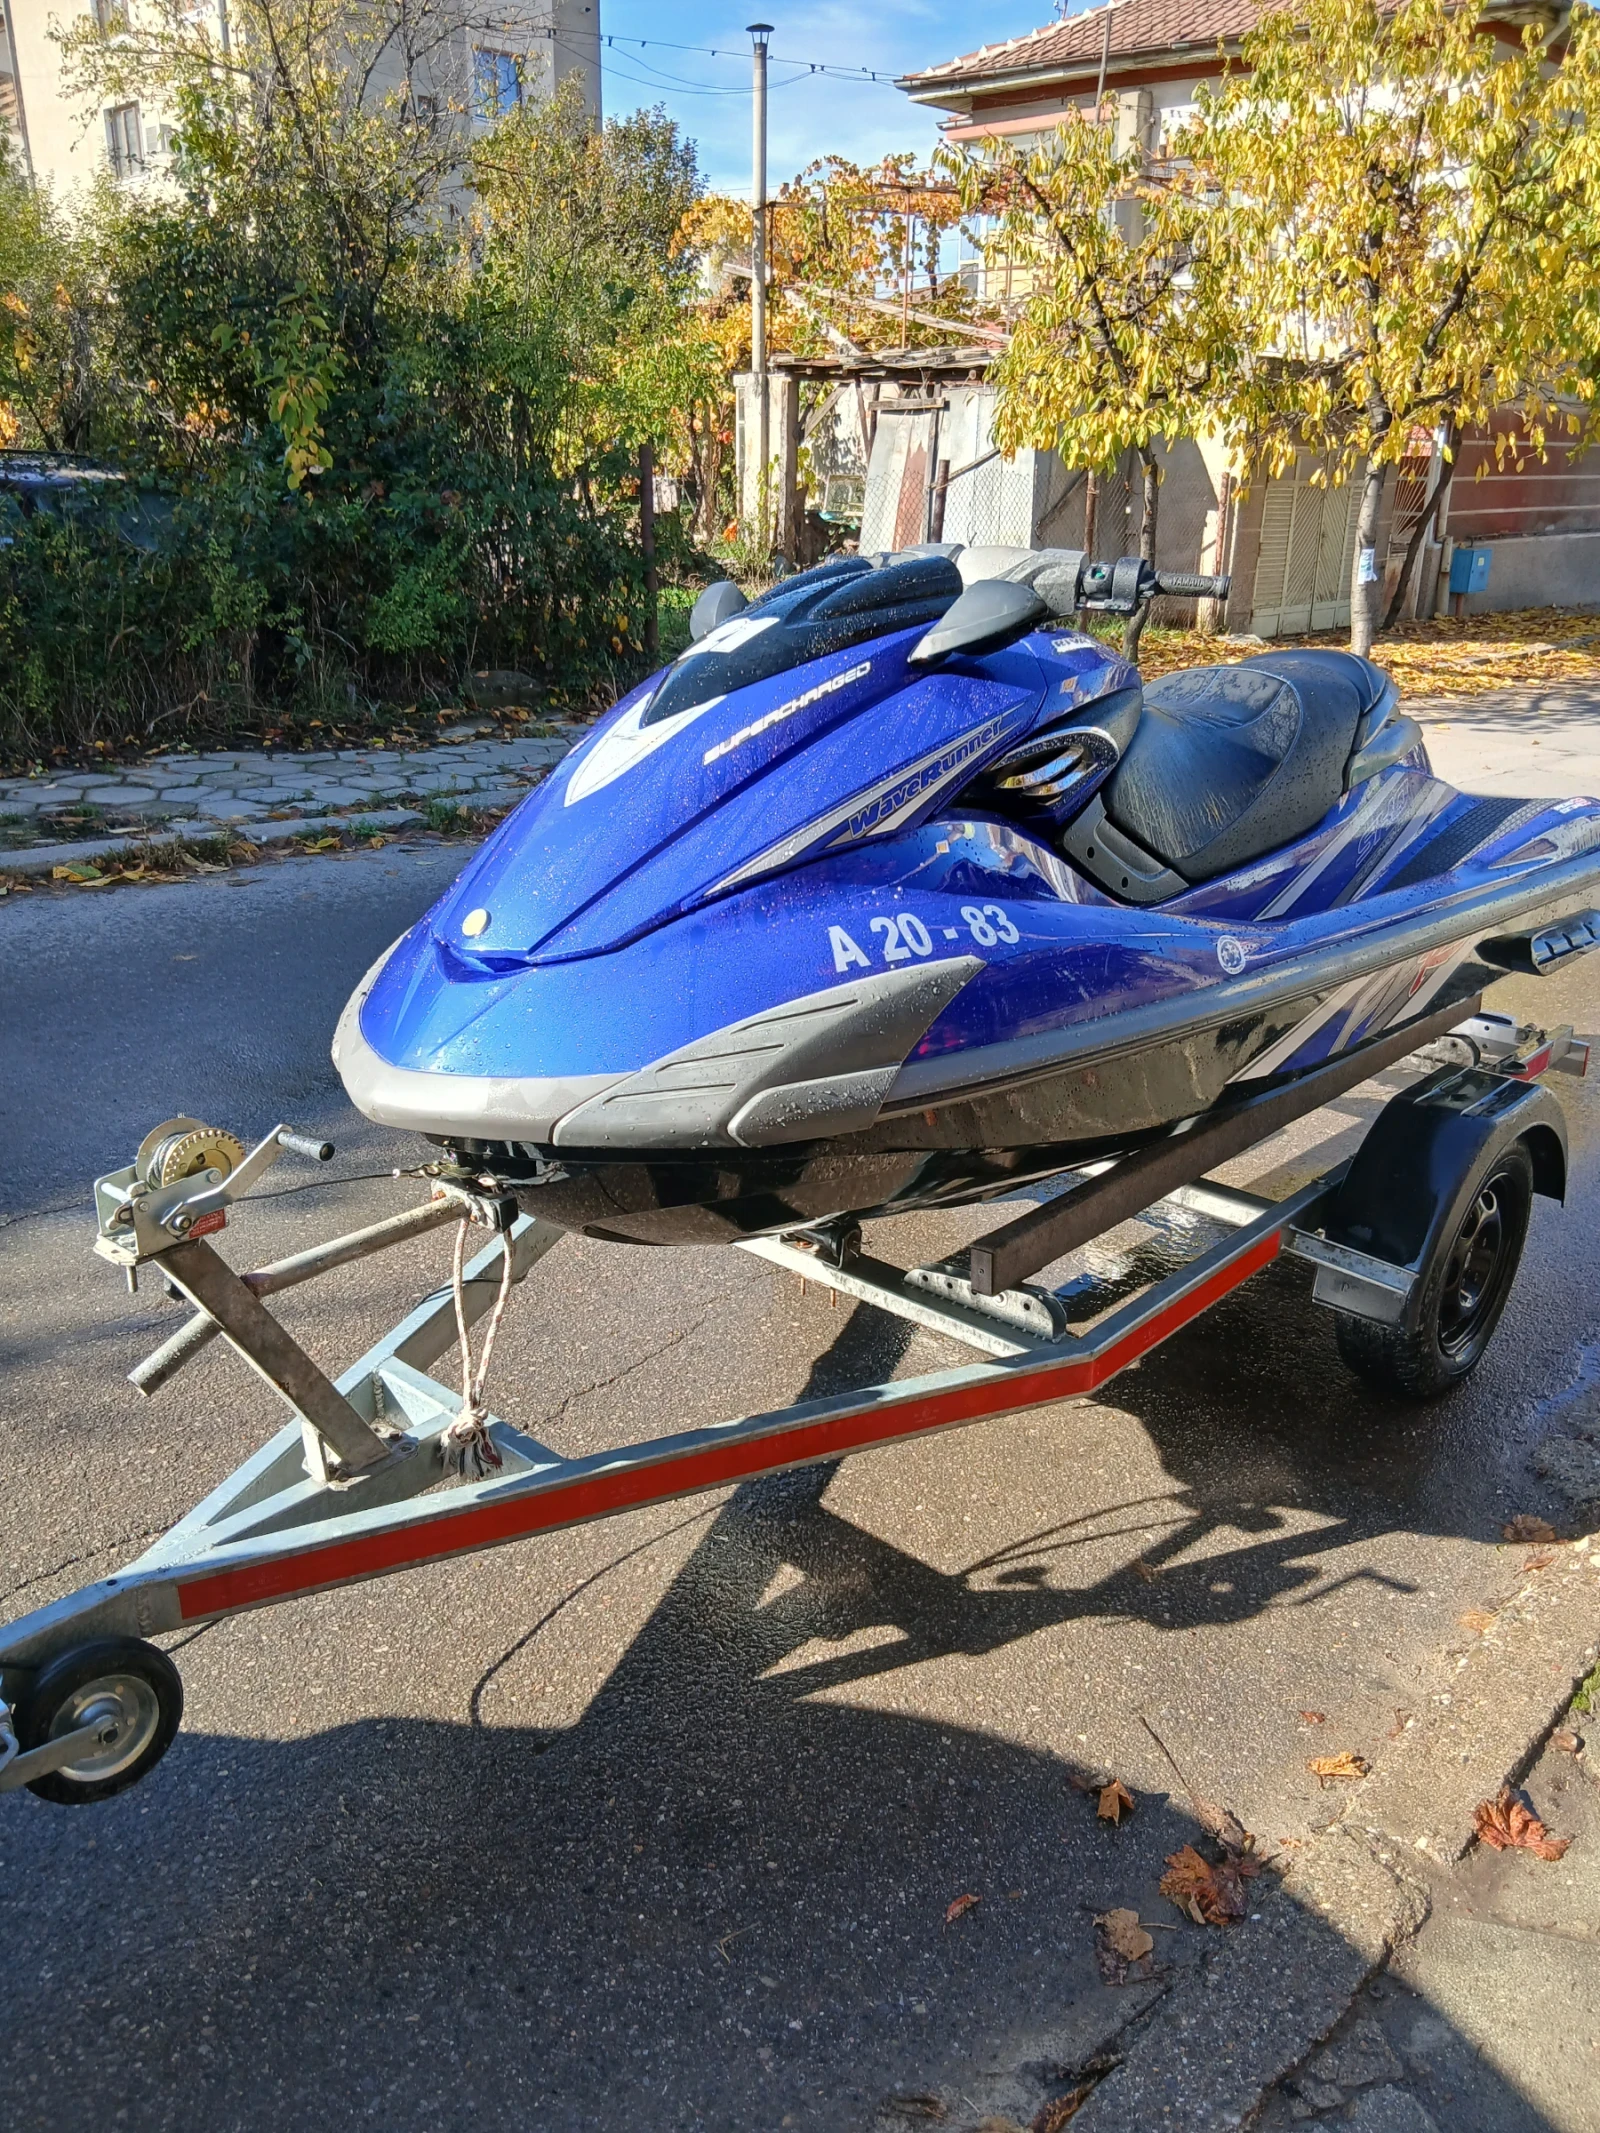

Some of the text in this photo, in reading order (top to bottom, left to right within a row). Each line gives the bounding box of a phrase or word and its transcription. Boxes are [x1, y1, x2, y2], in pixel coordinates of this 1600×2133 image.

[1172, 576, 1205, 588] YAMAHA
[702, 660, 872, 767] SUPERCHARGED
[849, 714, 1003, 838] WaveRunner
[828, 925, 871, 973] A
[870, 912, 933, 962] 20
[960, 904, 1020, 947] 83
